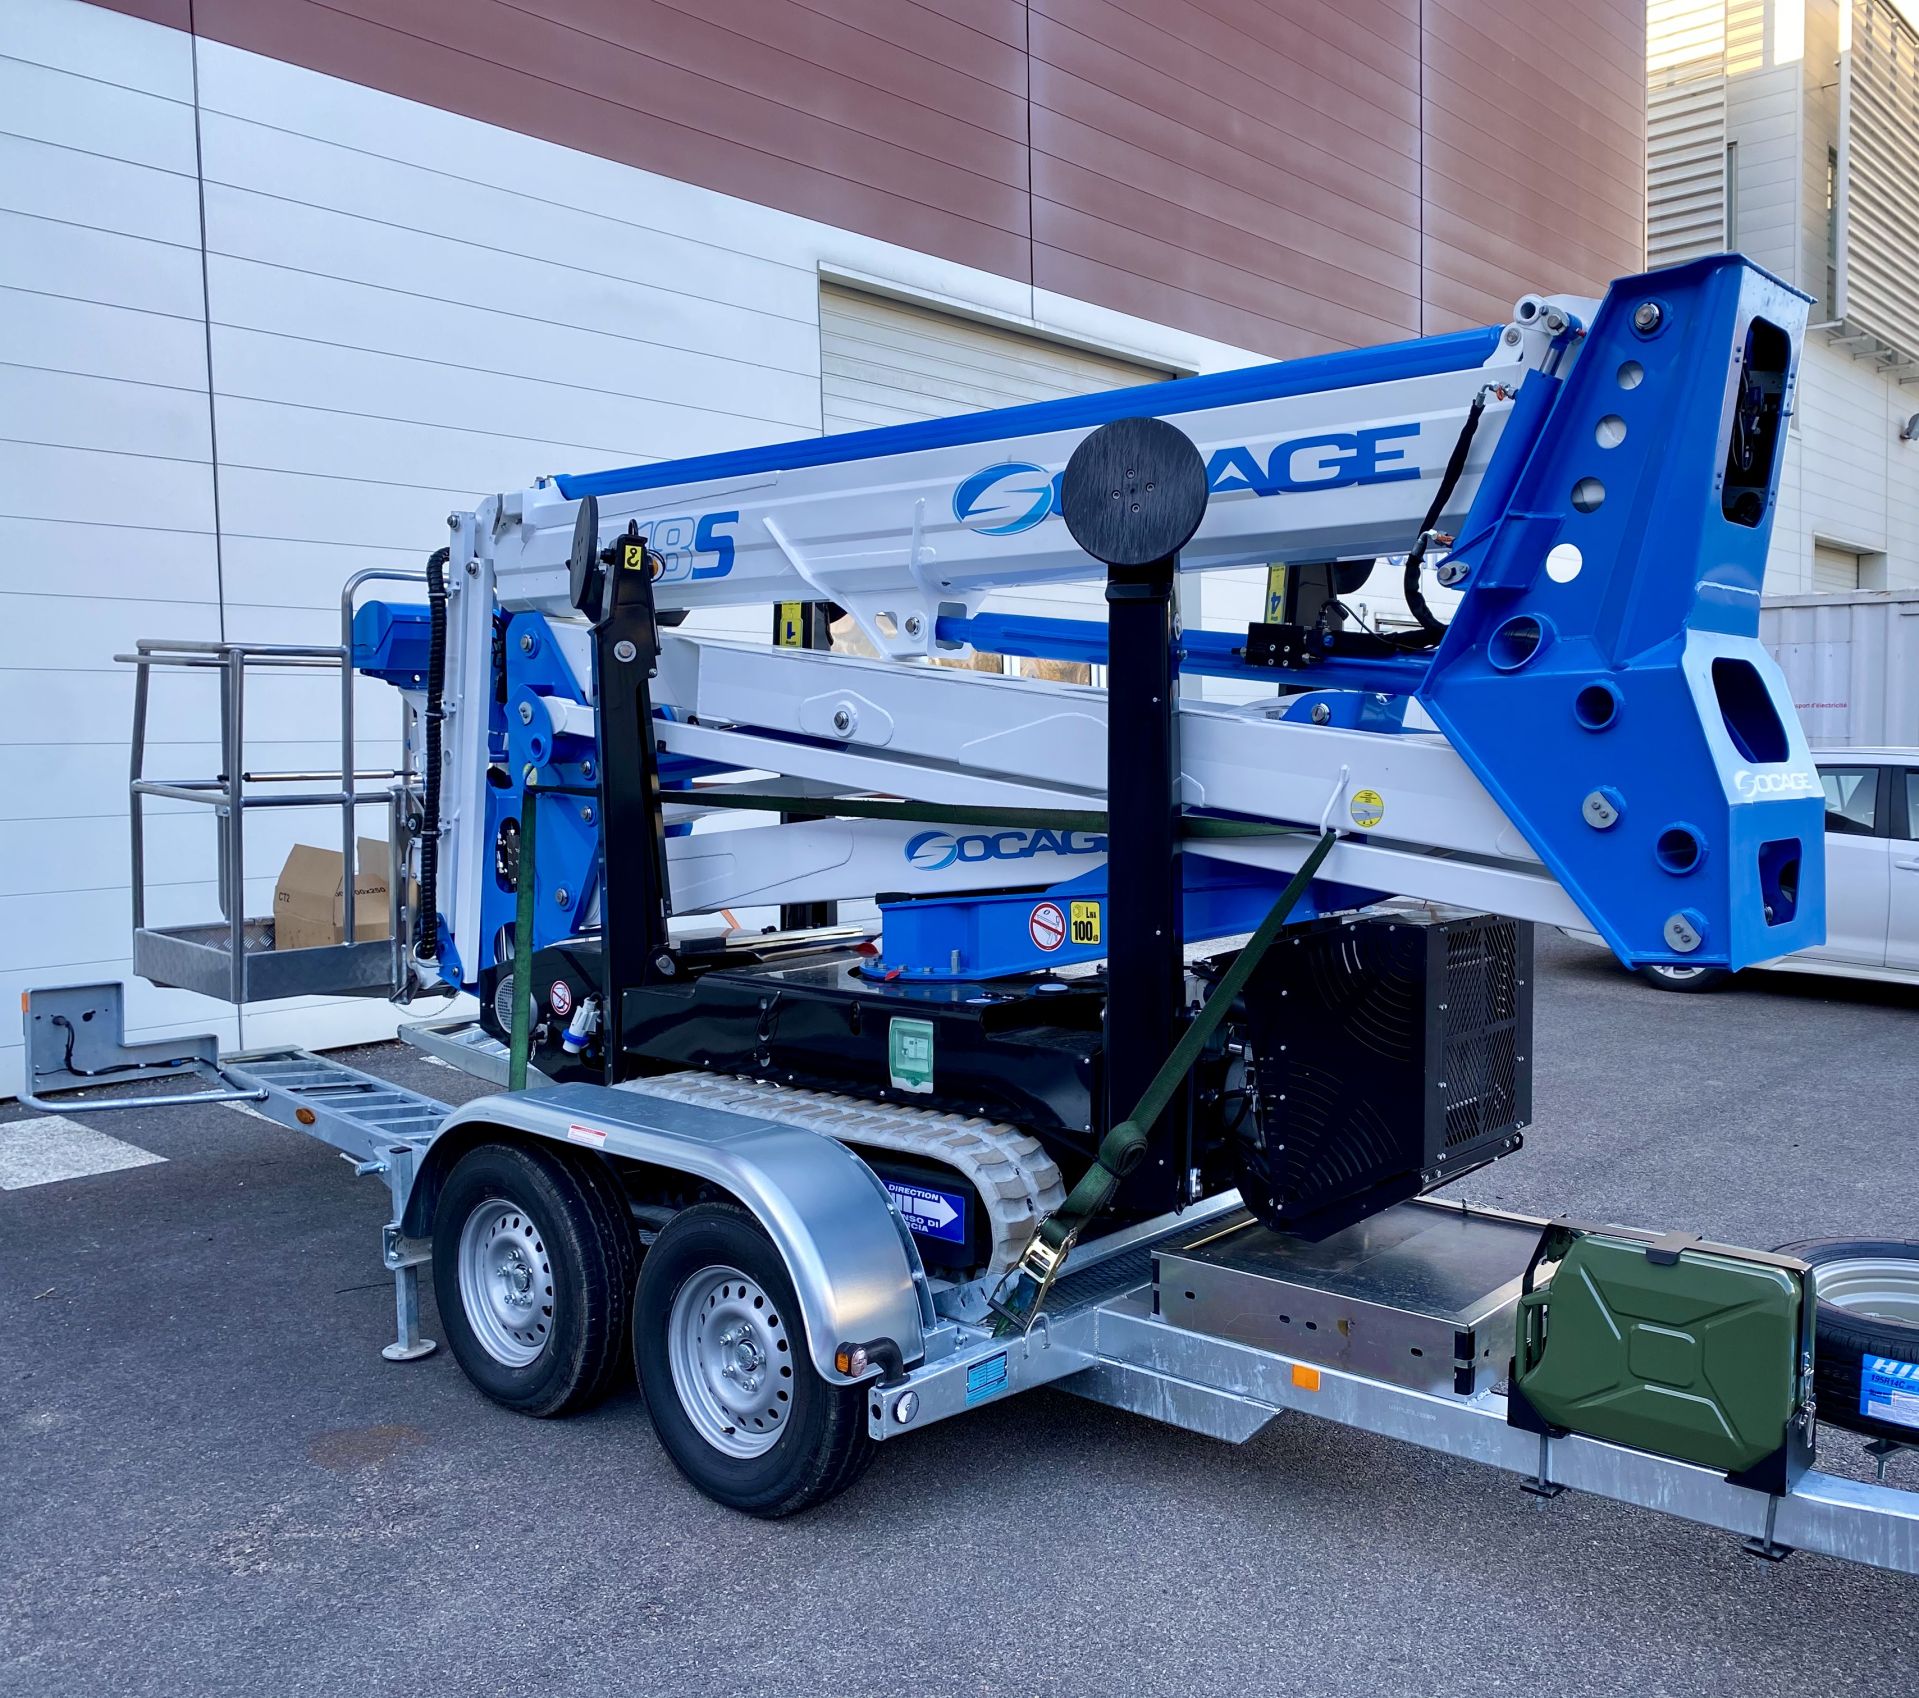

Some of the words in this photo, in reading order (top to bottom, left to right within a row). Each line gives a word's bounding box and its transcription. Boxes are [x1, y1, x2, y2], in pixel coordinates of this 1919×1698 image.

[952, 422, 1421, 536] SAGE
[1734, 769, 1812, 798] SOCAGE
[904, 829, 1108, 871] SOCAG
[1073, 920, 1093, 941] 100
[888, 1184, 938, 1201] DIRECTION
[902, 1213, 925, 1225] NSO
[927, 1219, 940, 1229] DI
